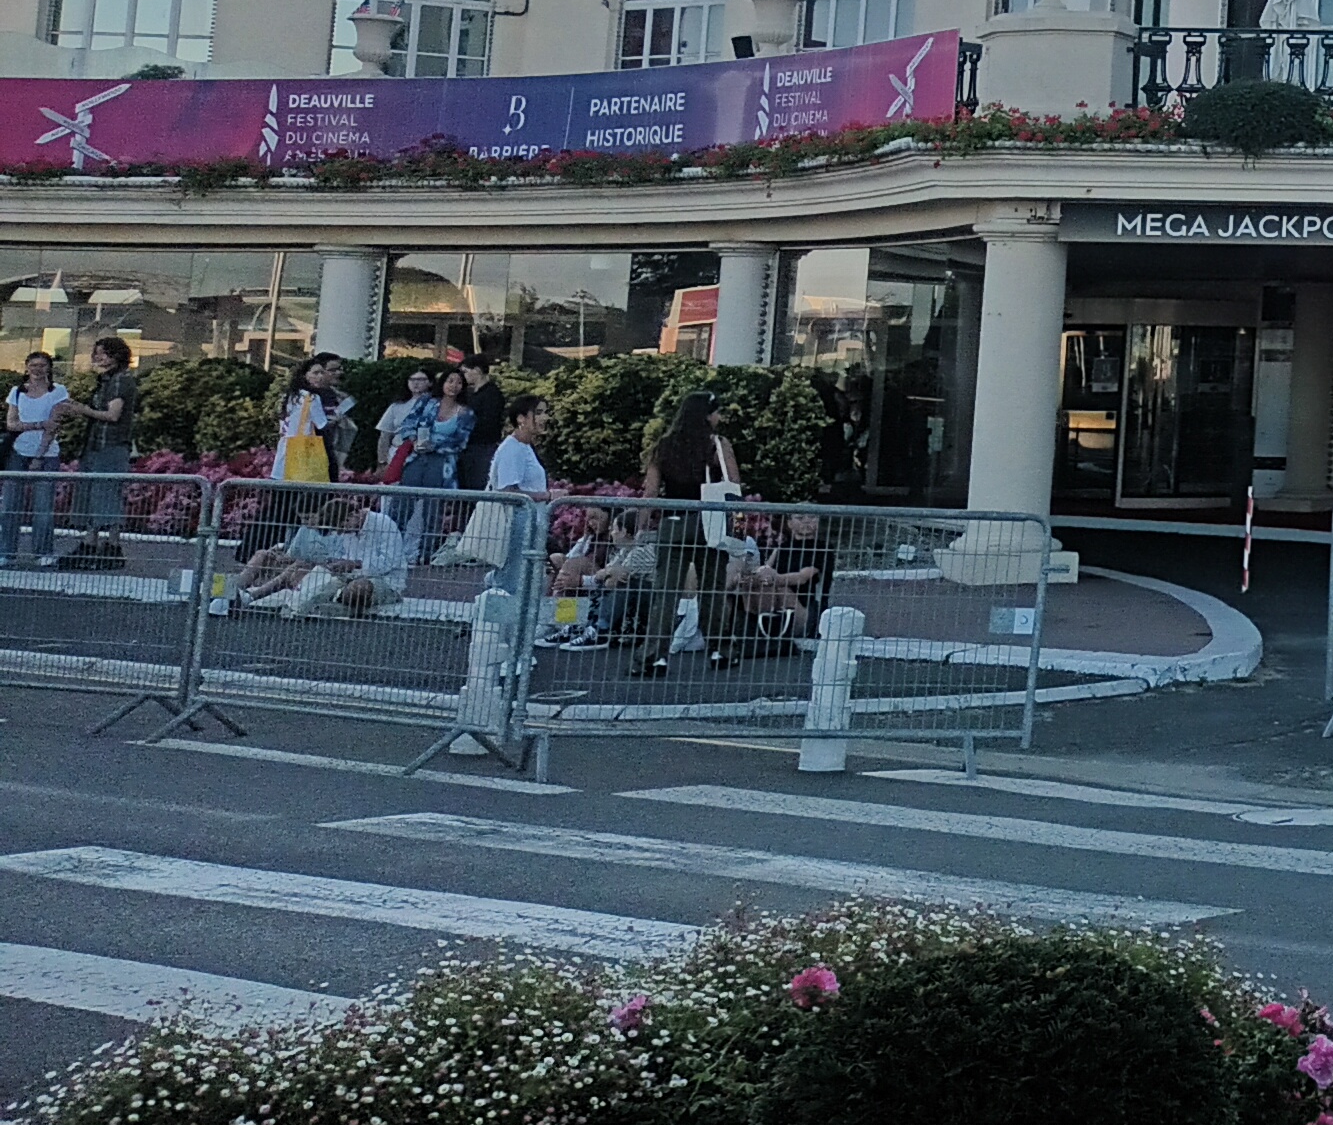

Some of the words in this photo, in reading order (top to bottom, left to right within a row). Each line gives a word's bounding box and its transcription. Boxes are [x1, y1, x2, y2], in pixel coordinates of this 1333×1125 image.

[776, 66, 833, 87] DEAUVILLE
[288, 94, 375, 108] DEAUVILLE
[589, 92, 686, 117] PARTENAIRE
[774, 90, 822, 108] FESTIVAL
[287, 114, 358, 127] FESTIVAL
[773, 113, 789, 127] DU
[285, 132, 307, 144] DU
[312, 130, 370, 144] CINÉMA
[585, 124, 684, 148] HISTORIQUE
[1116, 213, 1210, 237] MEGA
